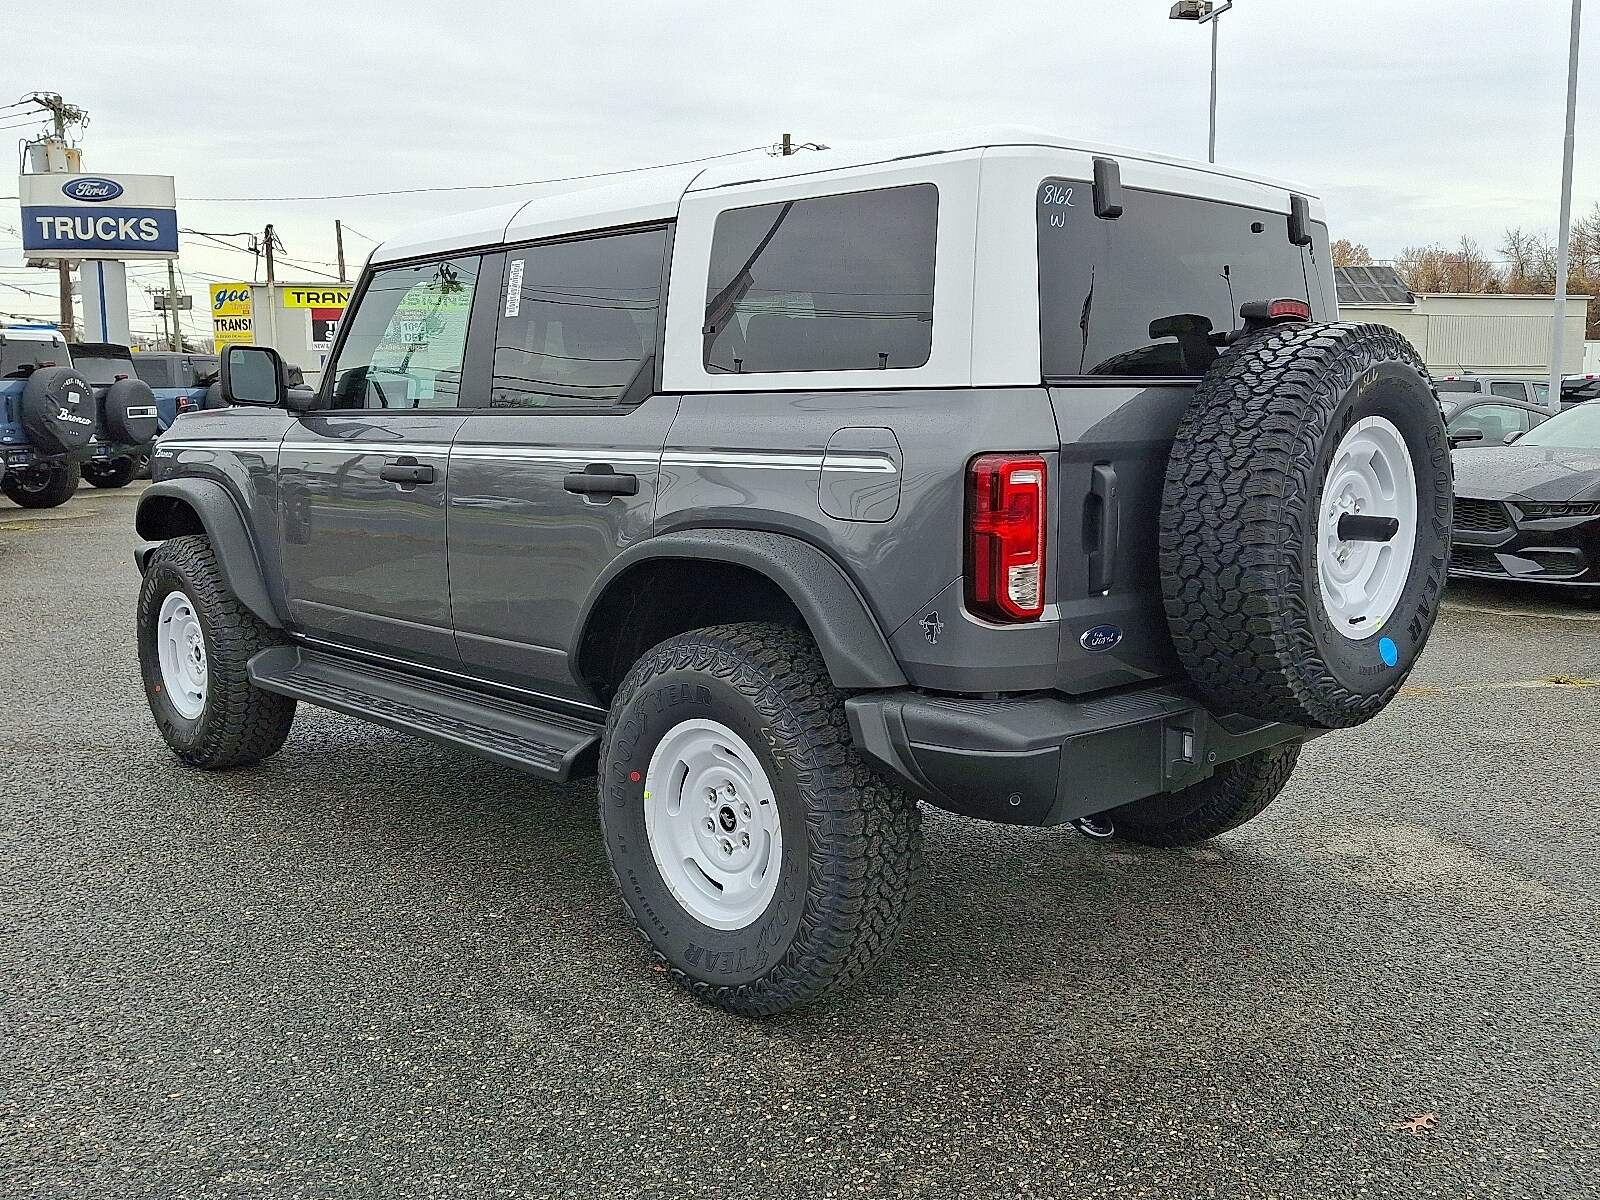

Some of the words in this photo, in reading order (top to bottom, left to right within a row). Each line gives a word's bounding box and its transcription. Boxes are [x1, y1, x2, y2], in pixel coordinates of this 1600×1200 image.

[75, 181, 109, 196] Ford
[1043, 184, 1075, 207] 8162
[35, 216, 160, 241] TRUCKS
[1050, 211, 1065, 228] W
[214, 288, 250, 310] goo
[56, 407, 92, 426] Bronco
